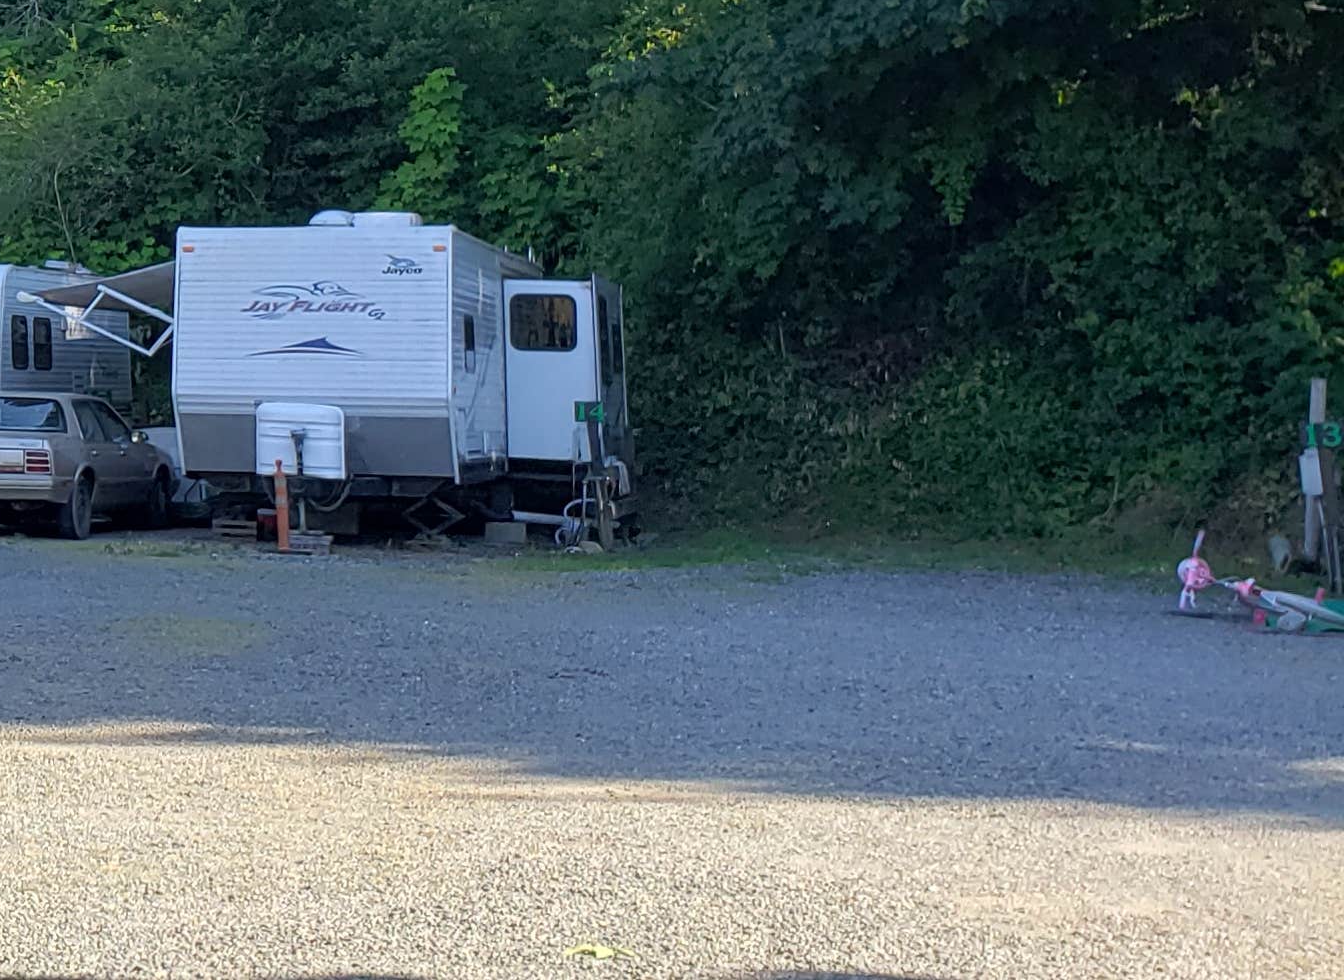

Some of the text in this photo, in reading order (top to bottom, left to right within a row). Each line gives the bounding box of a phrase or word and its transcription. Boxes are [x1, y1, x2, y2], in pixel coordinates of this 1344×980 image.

[382, 266, 423, 276] Jayco
[240, 300, 289, 312] JAY
[288, 300, 376, 312] FLIGHT
[576, 401, 605, 422] 14
[1305, 421, 1342, 448] 13
